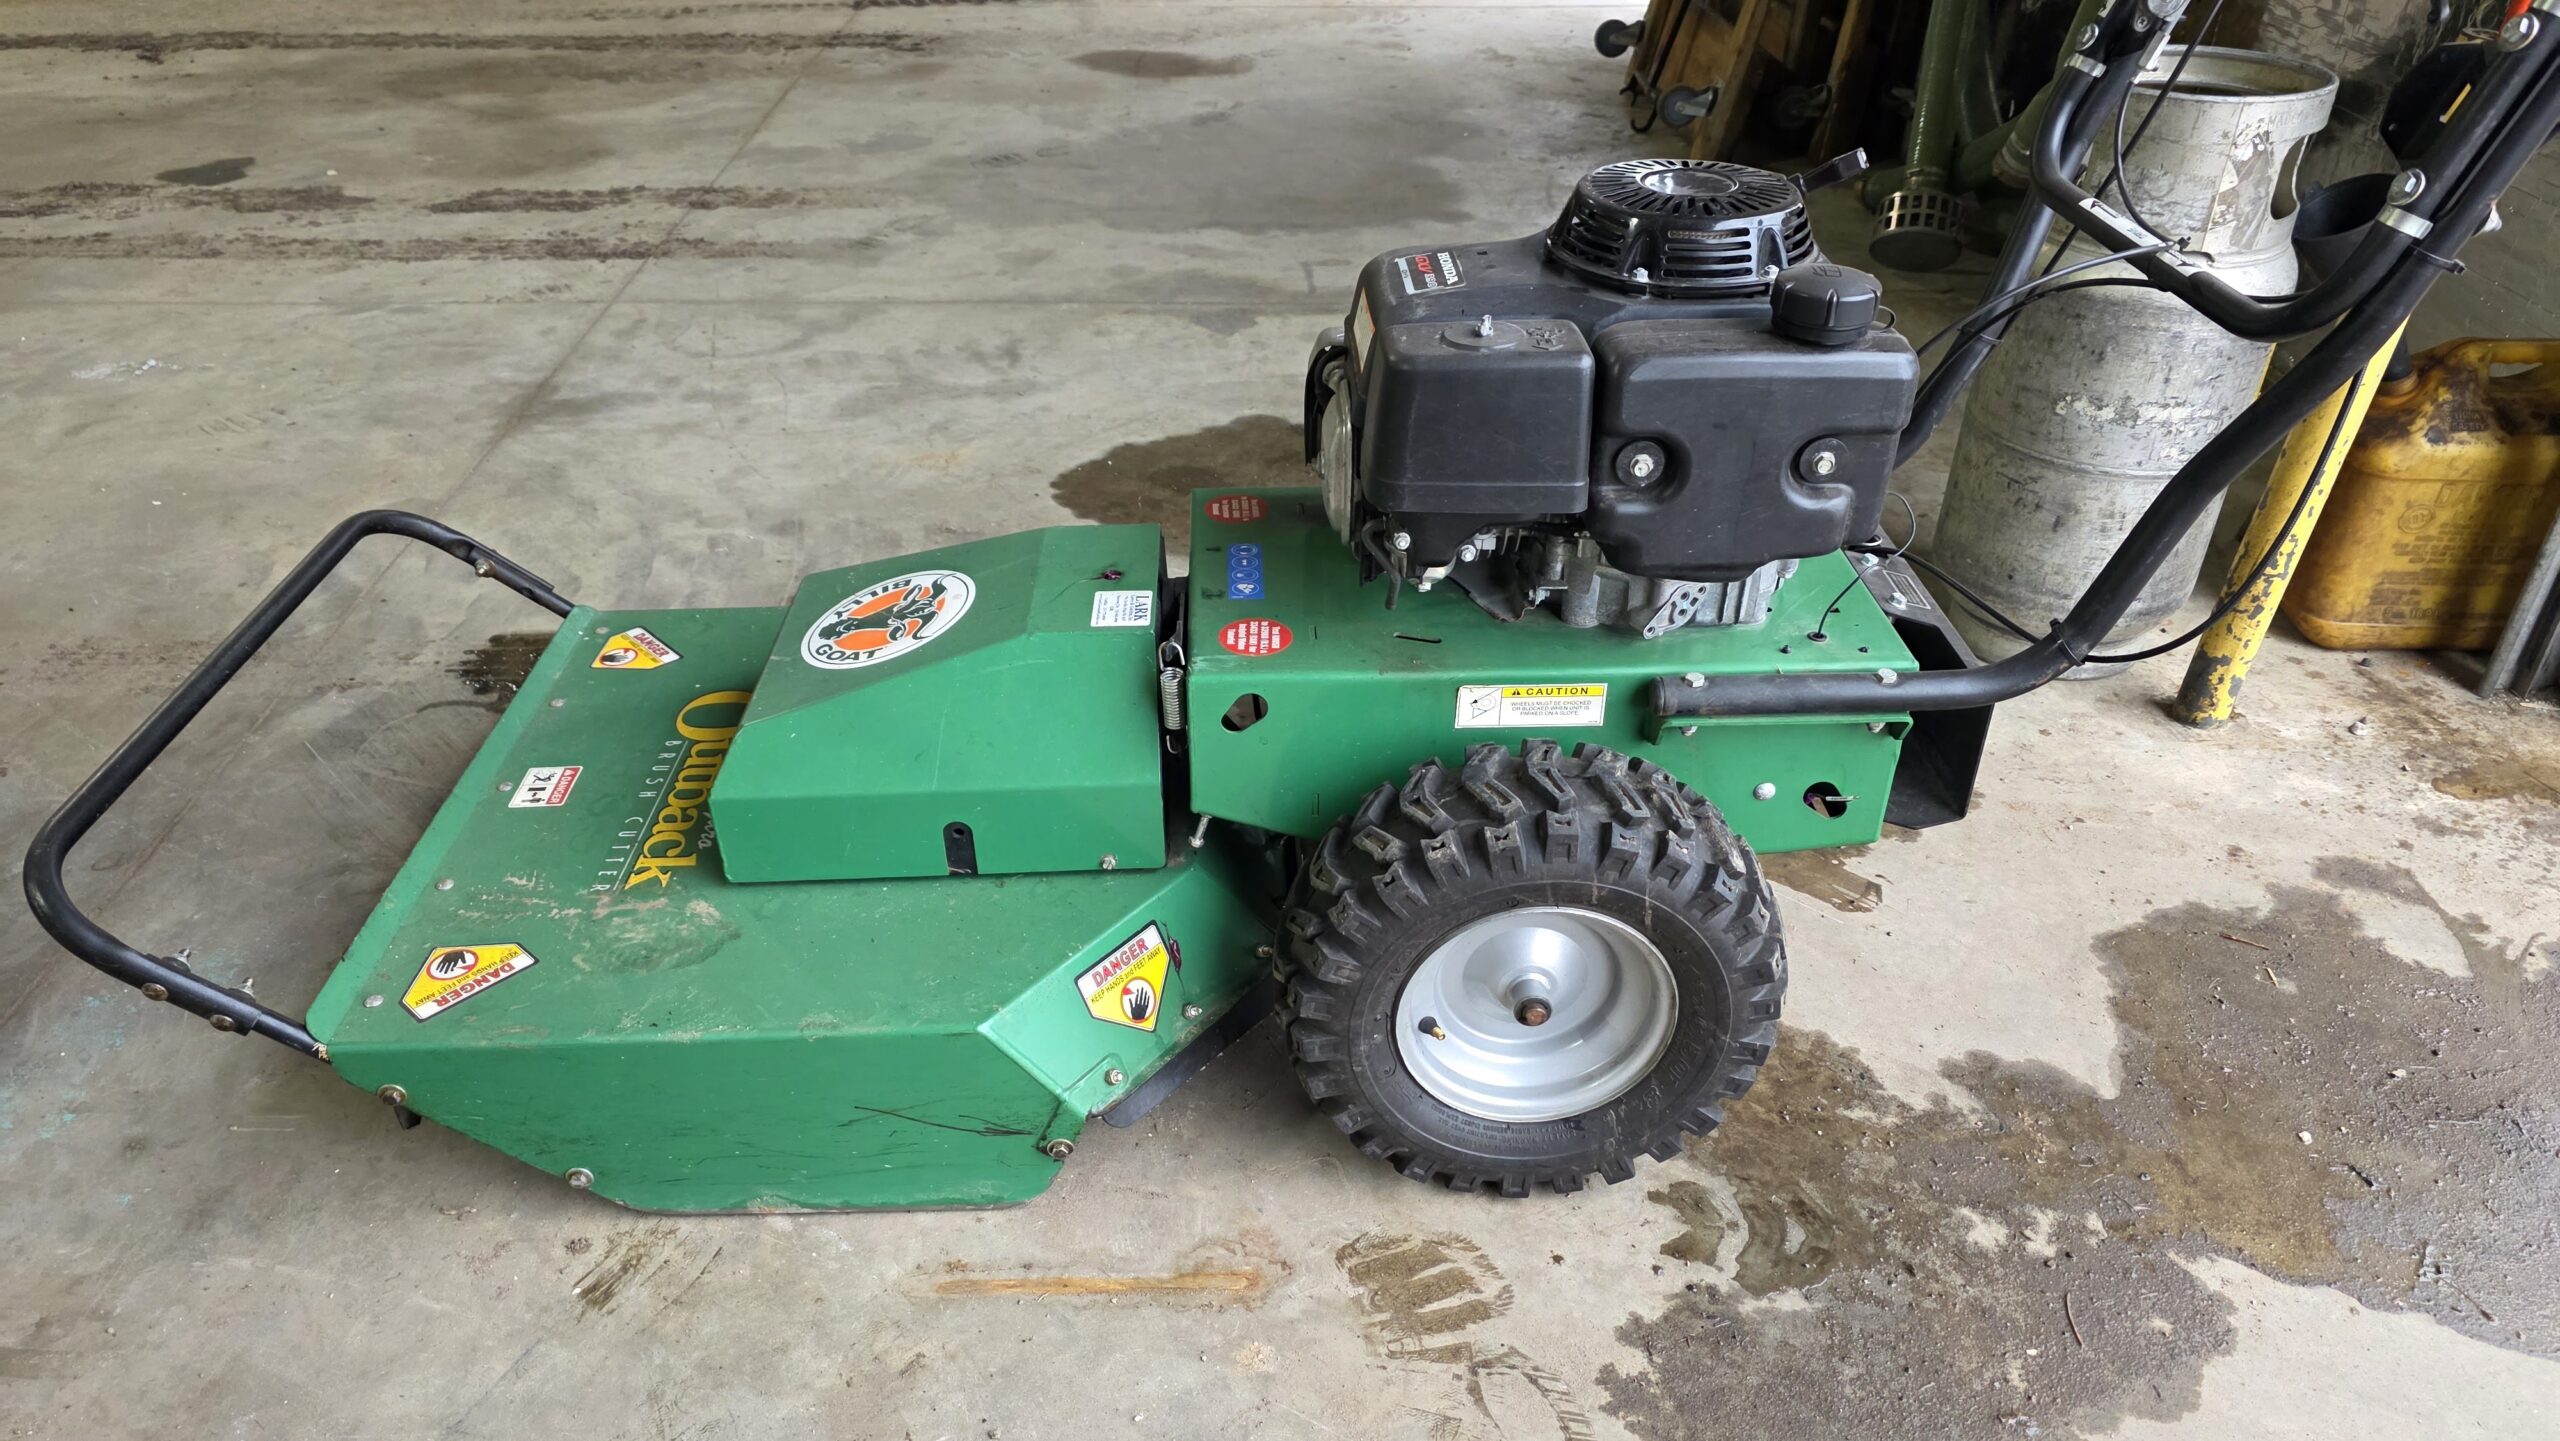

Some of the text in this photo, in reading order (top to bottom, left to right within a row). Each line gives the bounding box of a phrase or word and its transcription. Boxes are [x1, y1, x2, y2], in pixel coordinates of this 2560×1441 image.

[1437, 251, 1458, 285] HONDA
[834, 579, 912, 619] BILLY
[1133, 595, 1150, 621] LARK
[634, 632, 670, 657] DANGER
[815, 643, 883, 662] GOAT
[1526, 687, 1588, 695] CAUTION
[548, 775, 573, 804] DANGER
[590, 740, 682, 892] BRUSH CUTTER
[414, 950, 519, 1006] KEEP HANDS and FEET AWAY
[1091, 947, 1161, 1004] KEEP HANDS and FEET AWAY
[1092, 937, 1149, 988] DANGER
[432, 962, 516, 1007] DANGER
